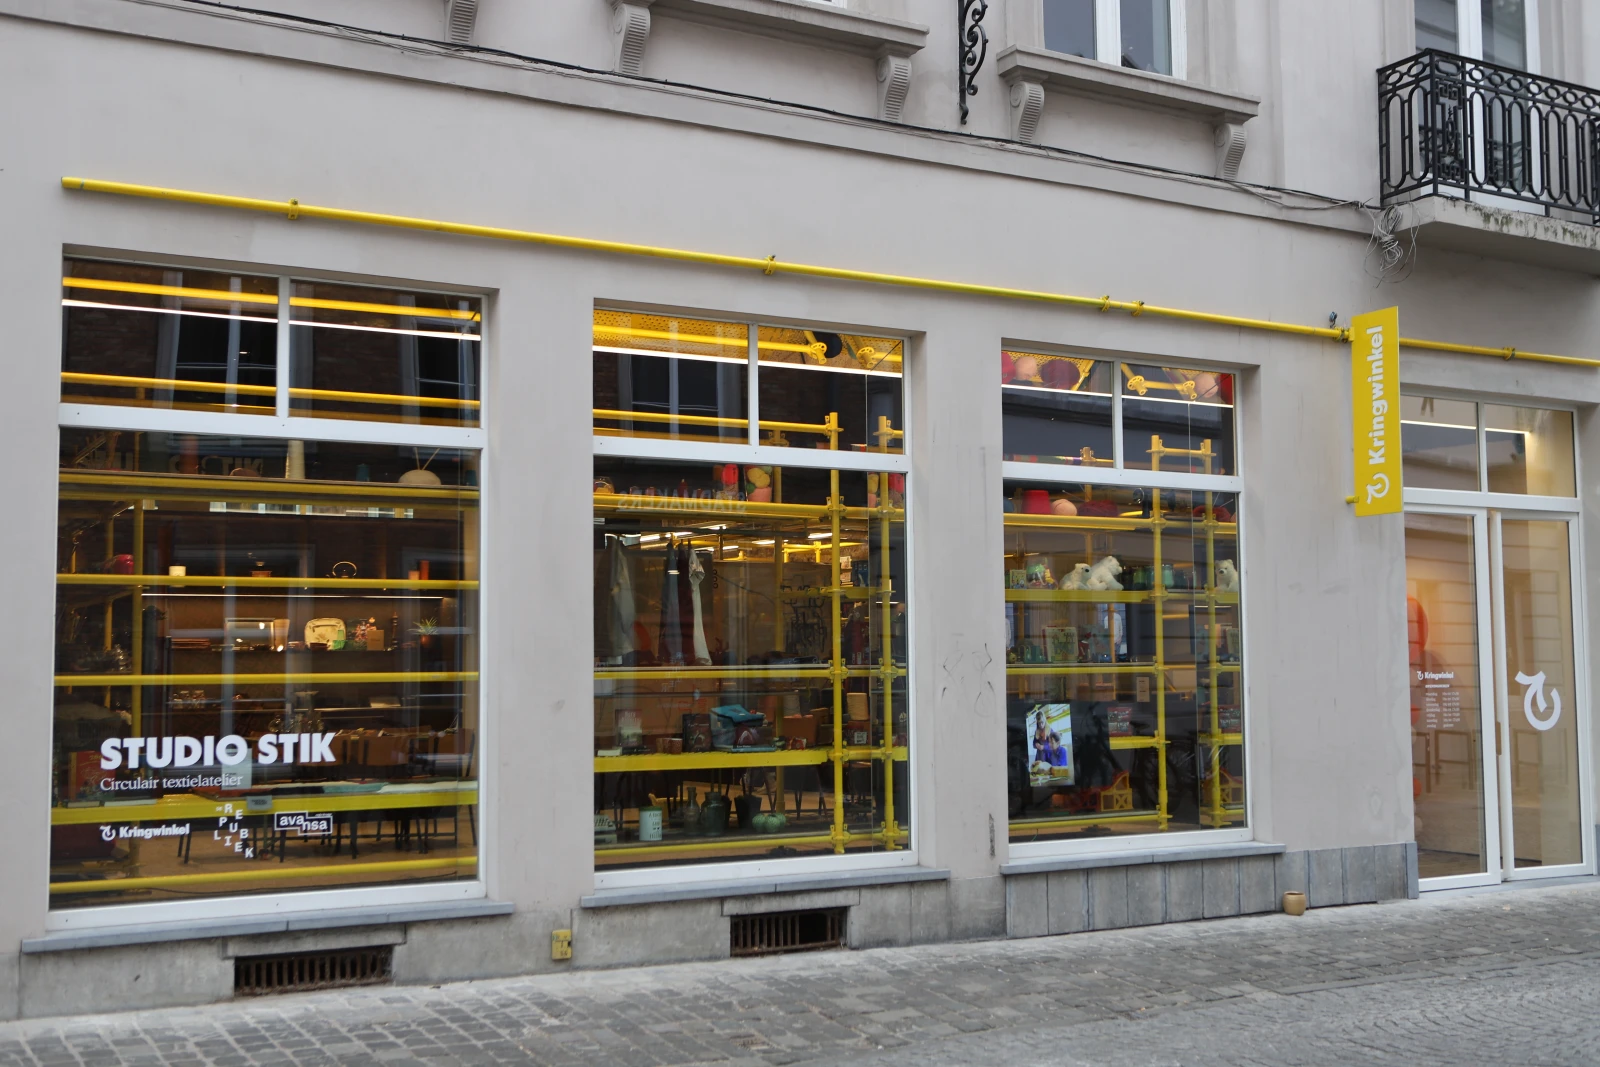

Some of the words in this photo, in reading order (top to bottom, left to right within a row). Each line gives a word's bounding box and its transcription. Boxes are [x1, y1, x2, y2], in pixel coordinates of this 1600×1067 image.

[1366, 325, 1388, 465] Kringwinkel
[1424, 671, 1455, 681] Kringwinkel
[100, 734, 248, 770] STUDIO
[258, 732, 337, 765] STIK
[100, 775, 158, 791] Circulair
[162, 773, 243, 789] textielatelier
[119, 823, 190, 840] Kringwinkel
